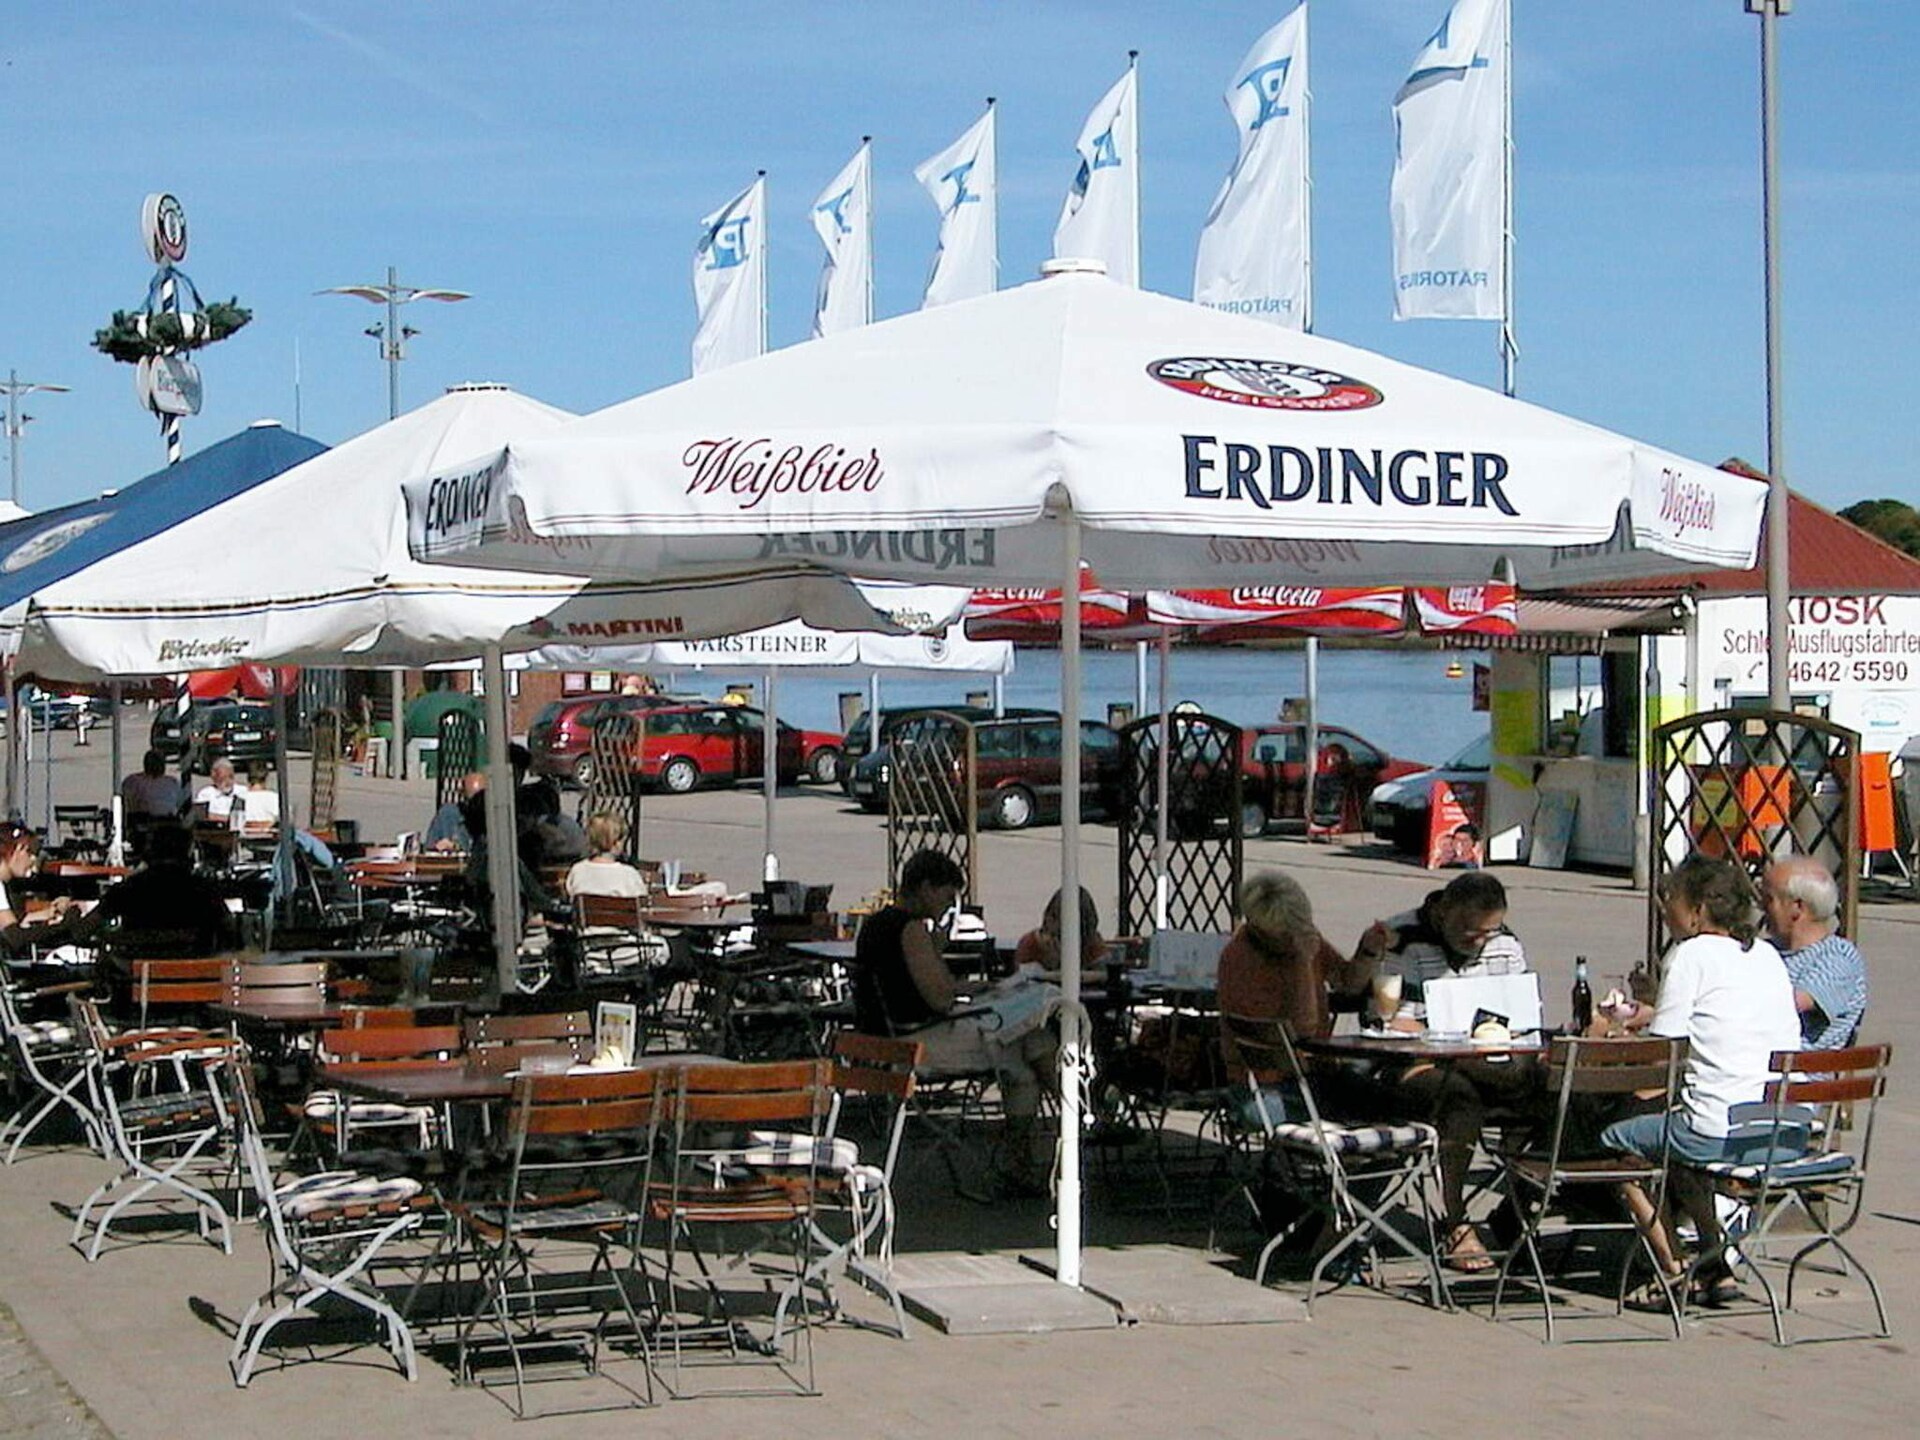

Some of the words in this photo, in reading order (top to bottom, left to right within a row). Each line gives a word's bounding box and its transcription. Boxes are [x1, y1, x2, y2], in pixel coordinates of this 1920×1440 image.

[683, 437, 884, 509] Weißbier
[1181, 434, 1521, 516] ERDINGER
[568, 607, 684, 637] MARTINI
[682, 635, 827, 652] WARSTEINER
